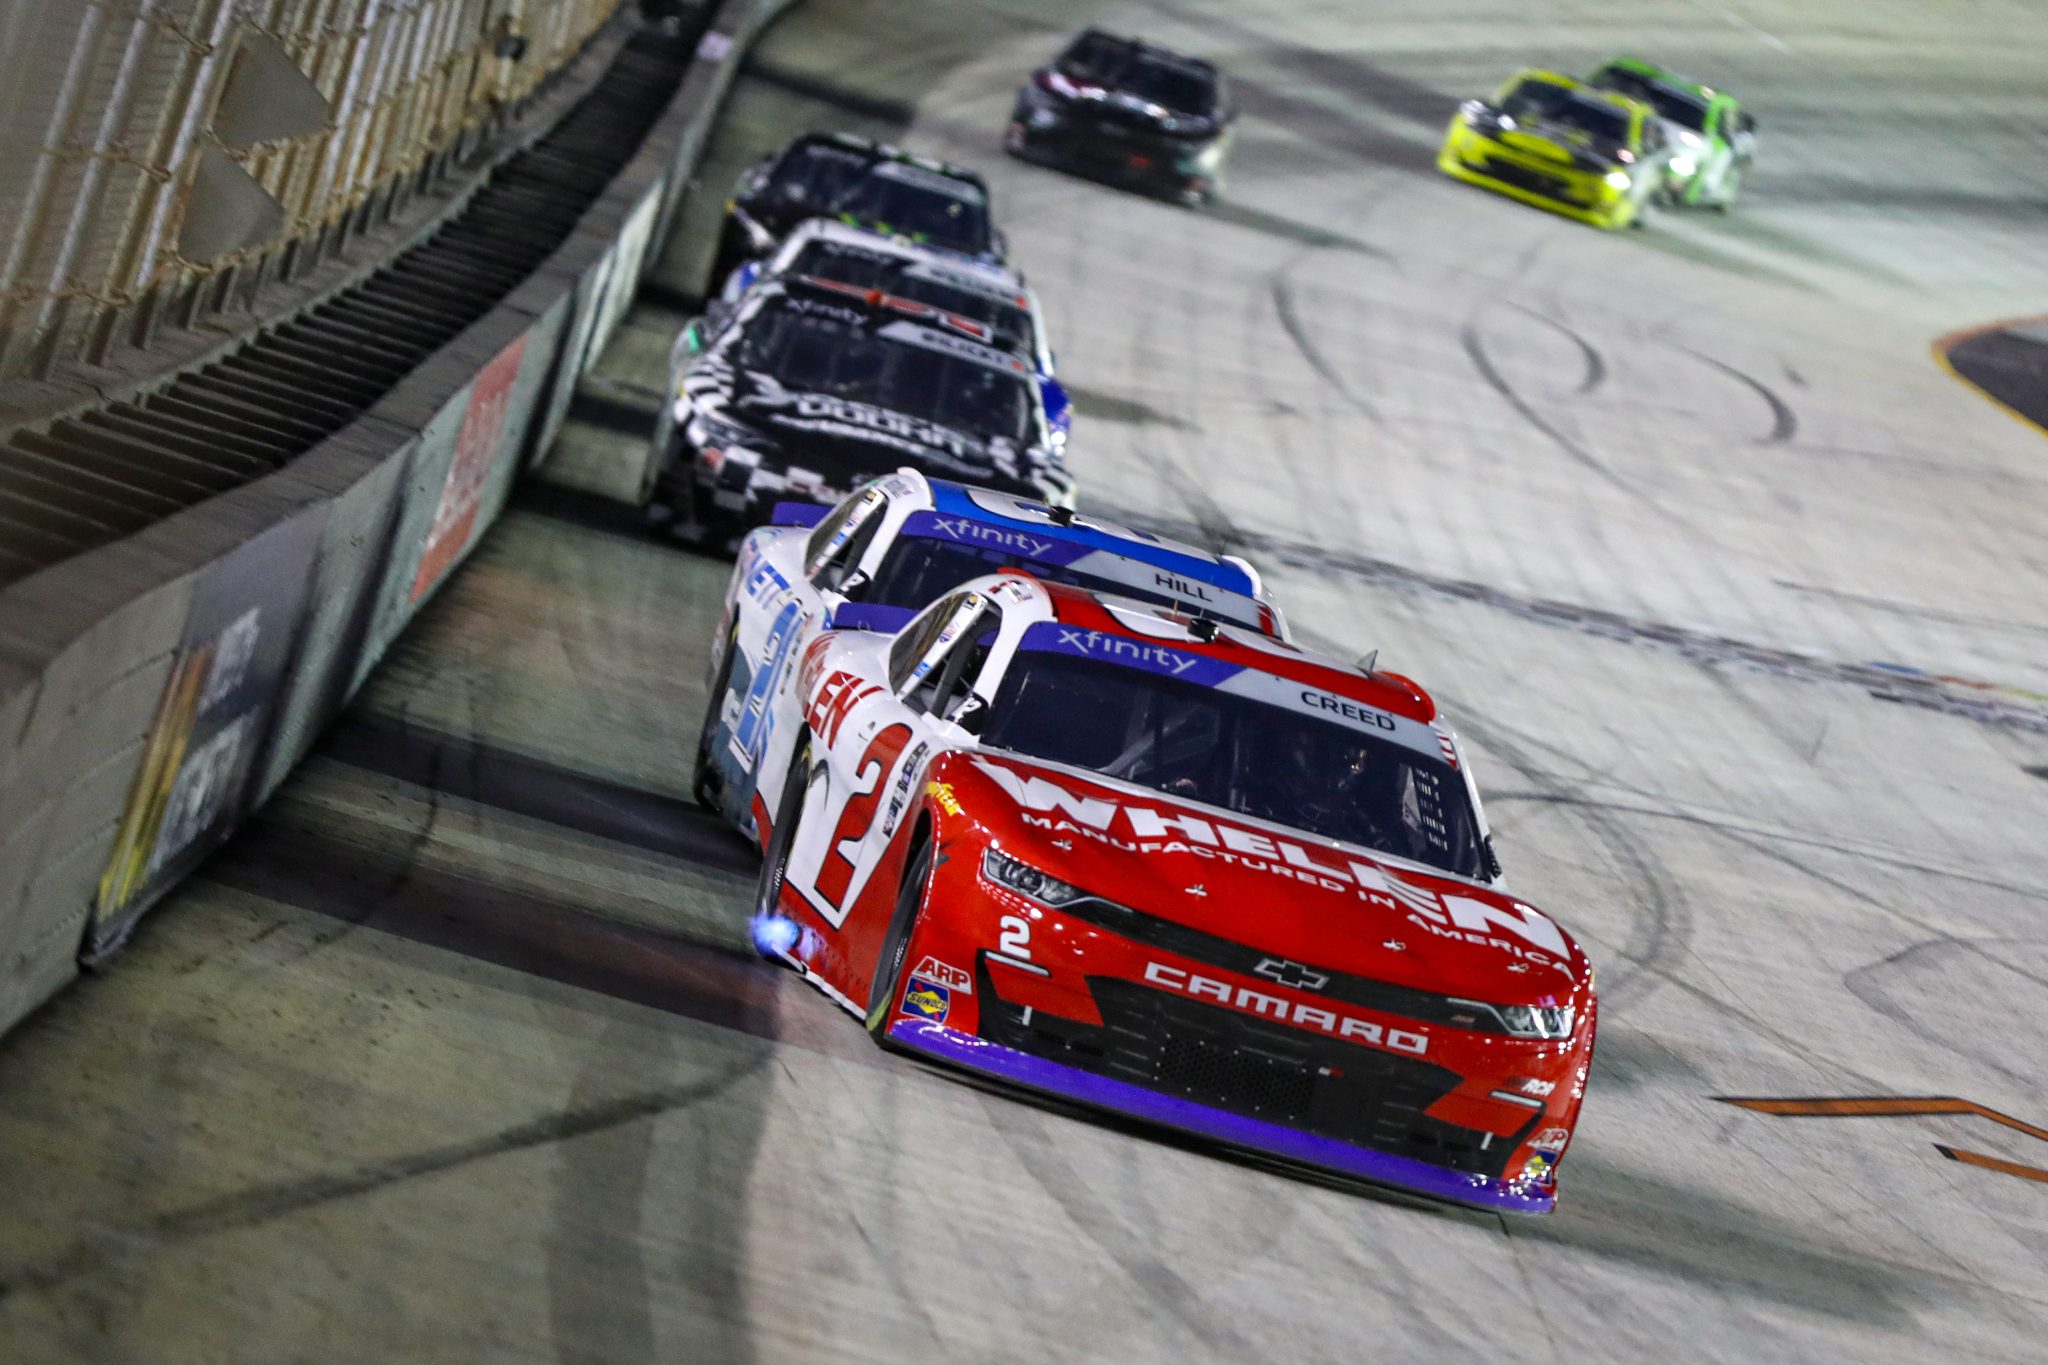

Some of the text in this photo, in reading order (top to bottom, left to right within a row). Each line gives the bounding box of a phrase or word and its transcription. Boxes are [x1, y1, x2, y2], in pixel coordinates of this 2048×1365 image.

[933, 517, 1053, 556] xfinity
[1154, 573, 1213, 603] HILL
[1057, 628, 1197, 674] xfinity
[1301, 690, 1397, 732] CREED
[971, 760, 1572, 961] WHELEN
[1021, 812, 1575, 984] MANUFACTURED IN AMERICA
[1000, 915, 1031, 960] 2
[915, 958, 971, 991] ARP
[908, 992, 948, 1012] SUNOCO
[1144, 961, 1429, 1055] CAMARO
